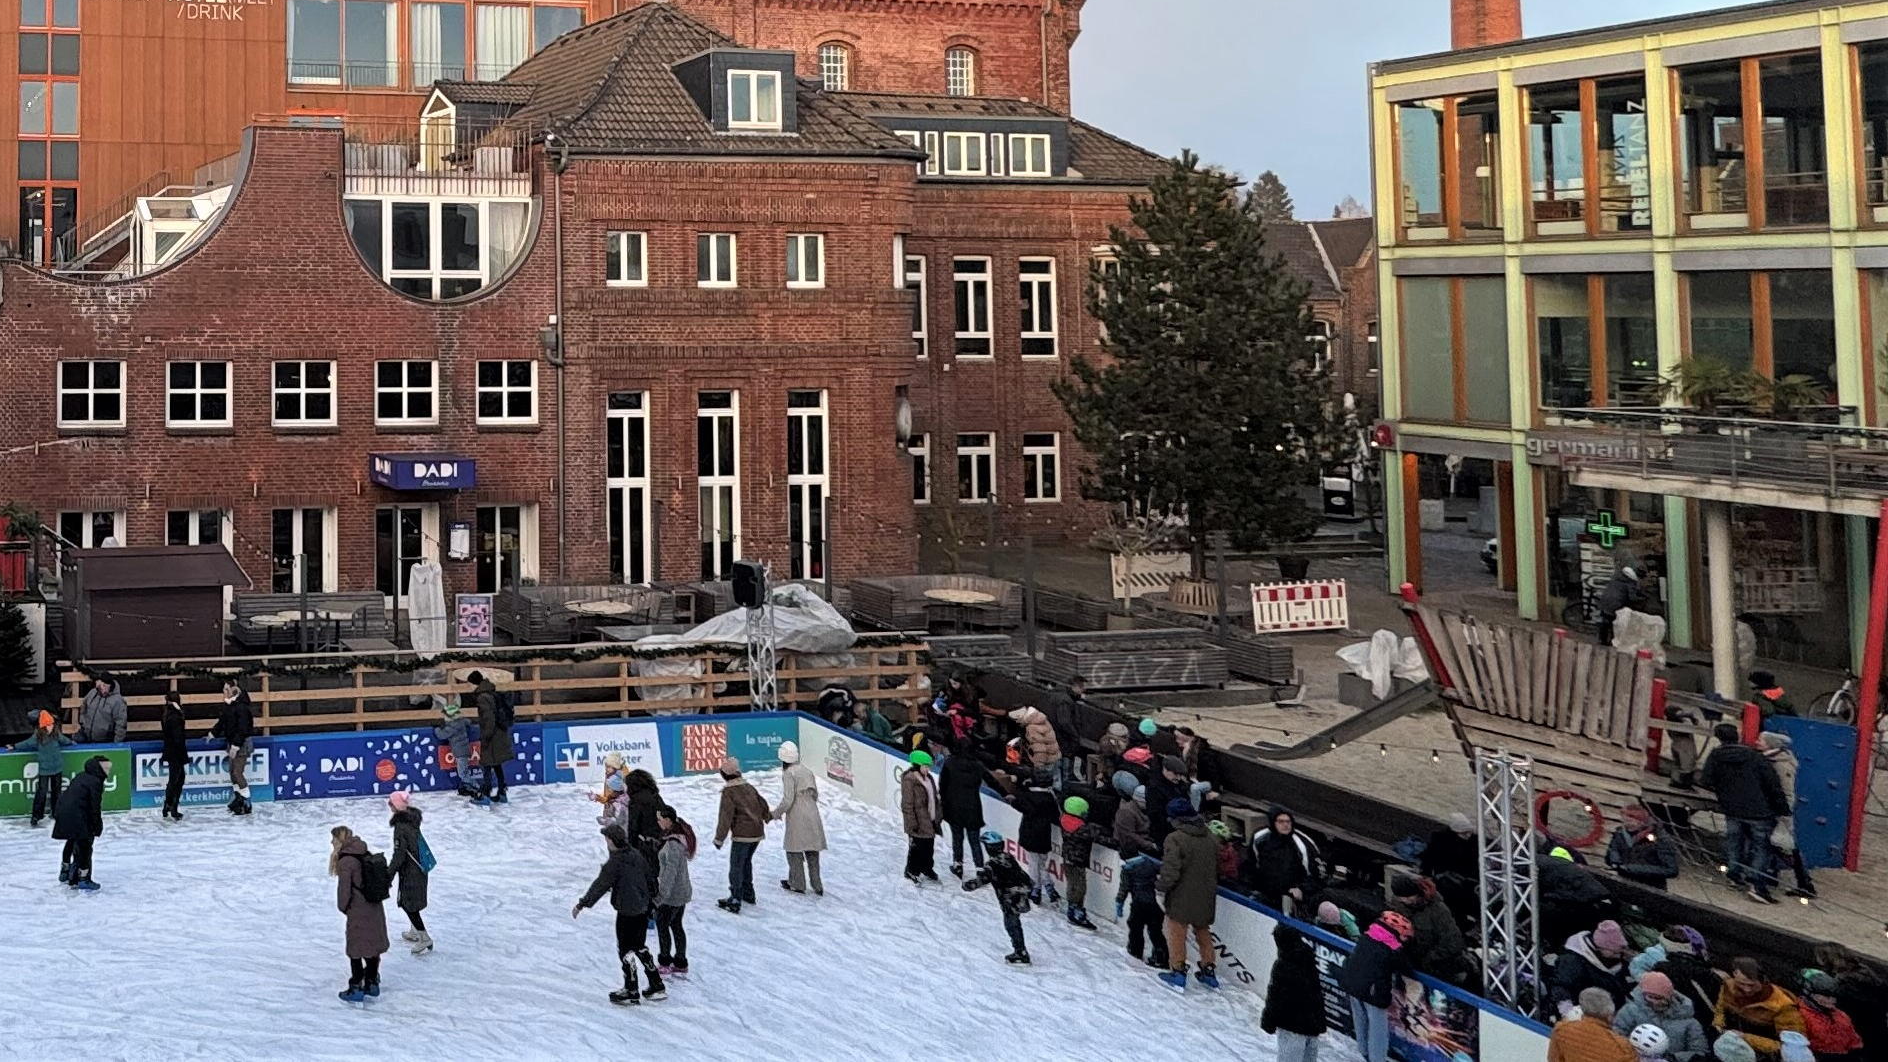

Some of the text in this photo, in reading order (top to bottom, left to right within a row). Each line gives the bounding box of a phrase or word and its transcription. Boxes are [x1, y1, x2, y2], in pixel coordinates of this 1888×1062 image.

[414, 462, 458, 478] DADI
[1090, 653, 1201, 688] GAZA
[683, 724, 727, 736] TAPAS
[595, 739, 652, 752] Volksbank
[683, 736, 727, 748] TAPAS
[746, 734, 756, 745] la
[684, 747, 727, 760] TAPAS
[320, 756, 364, 773] DADI
[596, 755, 643, 766] Mster
